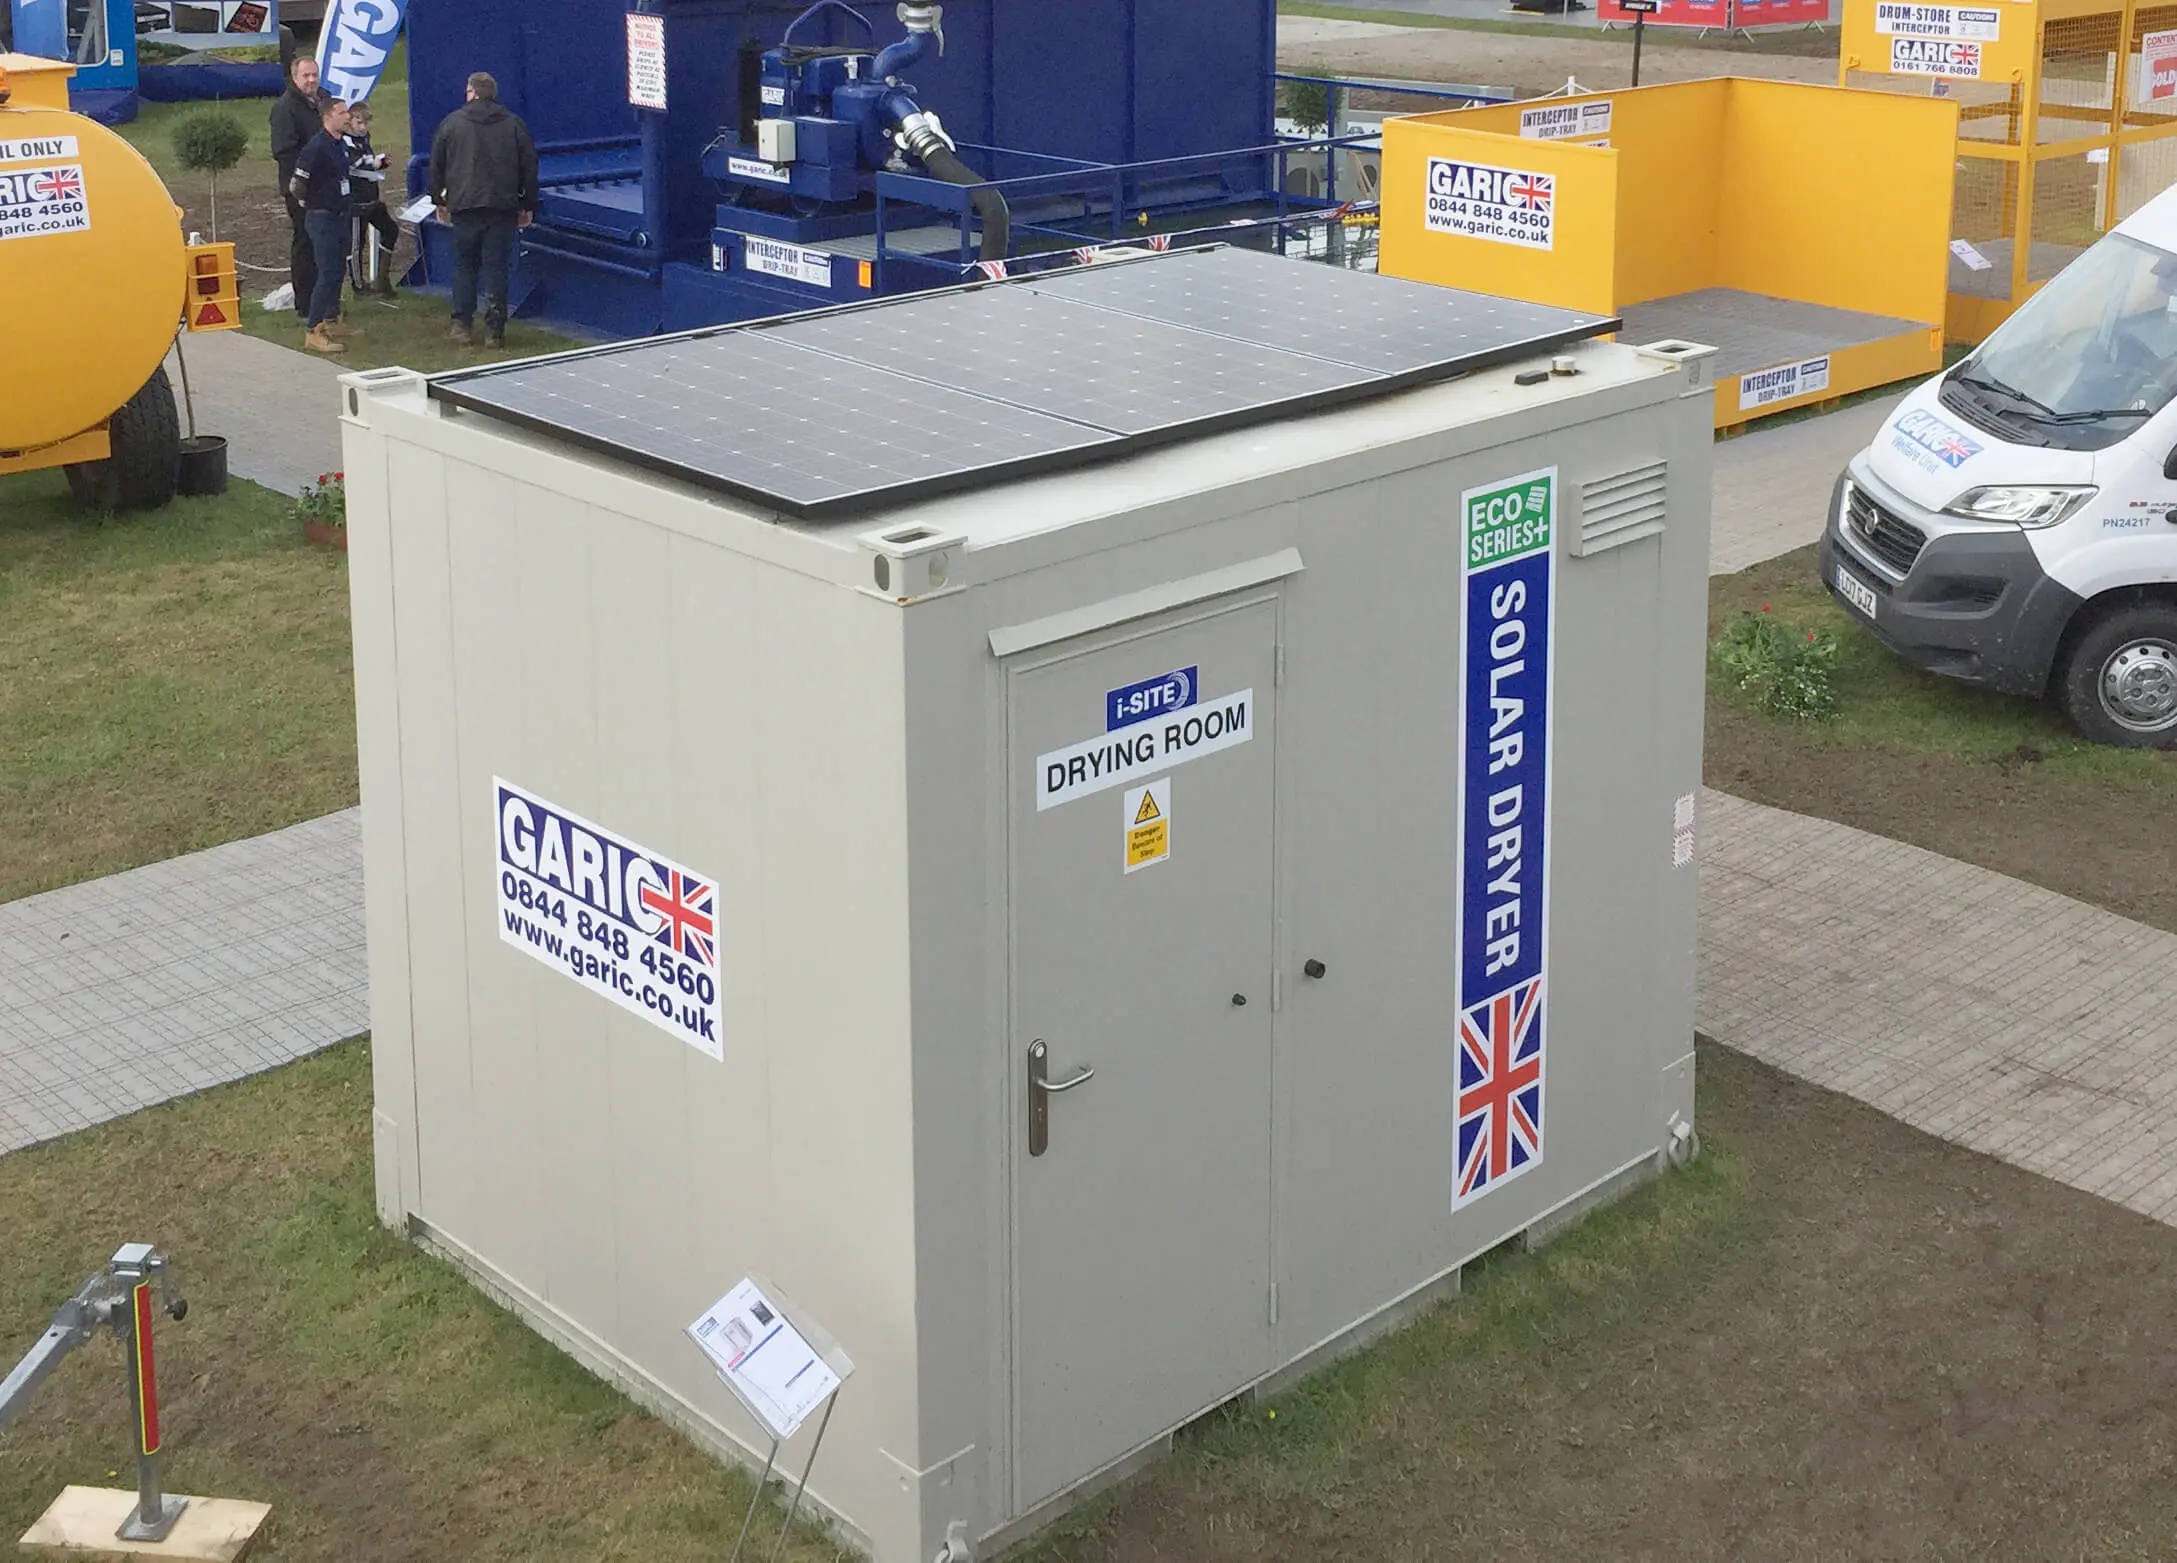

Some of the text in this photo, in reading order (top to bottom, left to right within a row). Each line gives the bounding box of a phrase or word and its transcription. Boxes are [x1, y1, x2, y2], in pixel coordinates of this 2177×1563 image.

[1879, 4, 1951, 23] DRUM-STORE
[1892, 22, 1950, 35] INTERCEPTOR
[1894, 39, 1962, 64] GARIC
[1893, 61, 1978, 76] 0161 766 8808
[1522, 107, 1578, 127] INTERCEPTOR
[1538, 125, 1577, 138] DRIP-TRAY
[21, 140, 63, 157] ONLY
[1431, 163, 1525, 207] GARIC
[39, 201, 83, 216] 4560
[1429, 197, 1550, 229] 0844 848 4560
[1428, 213, 1549, 243] www.garic.co.uk
[747, 240, 799, 264] INTERCEPTOR
[1743, 366, 1797, 394] INTERCEPTOR
[1758, 384, 1795, 403] DRIP-TRAY
[1471, 492, 1523, 532] ECO
[2103, 517, 2151, 528] PN24217
[1471, 515, 1549, 562] SERIES+
[1116, 681, 1176, 719] i-SITE
[1047, 702, 1246, 794] DRYING ROOM
[1485, 579, 1527, 978] SOLAR DRYER
[1134, 825, 1161, 839] Danger
[501, 796, 665, 936] GARIC
[501, 871, 715, 1006] 0844 848 4560
[503, 908, 716, 1043] www.garic.co.uk
